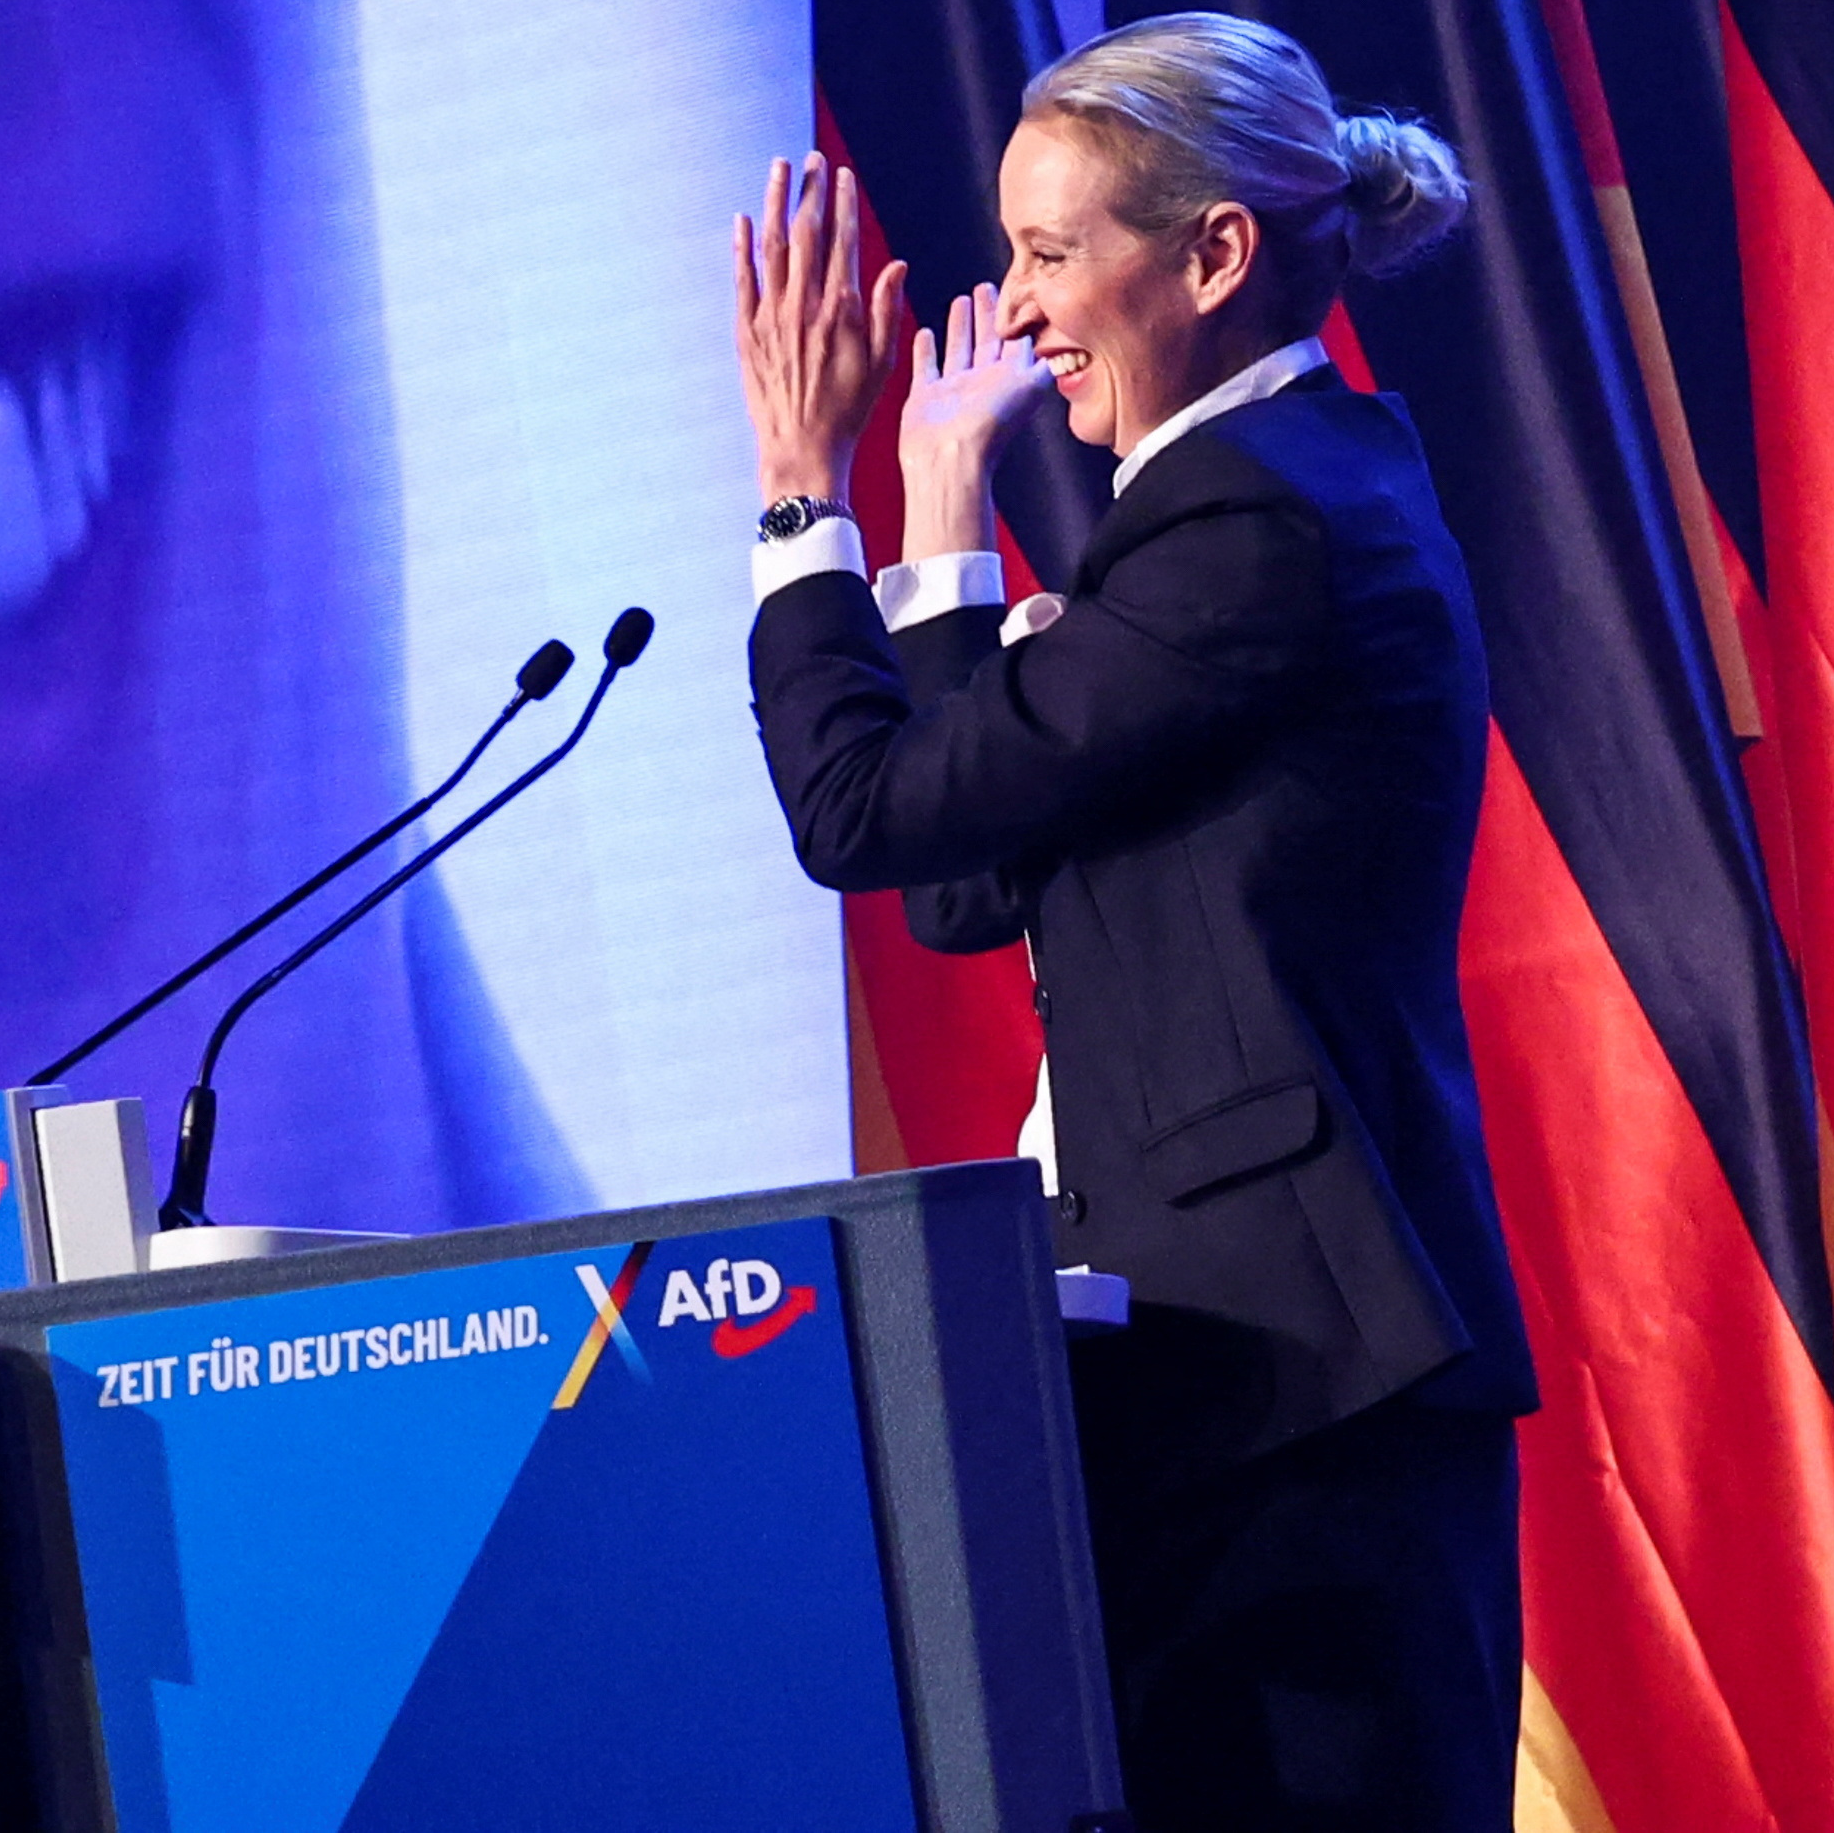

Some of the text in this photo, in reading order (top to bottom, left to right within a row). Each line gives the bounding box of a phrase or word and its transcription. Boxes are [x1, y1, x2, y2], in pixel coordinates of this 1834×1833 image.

[657, 1258, 782, 1329] AfD
[96, 1305, 550, 1408] ZEIT FÜR DEUTSCHLAND.
